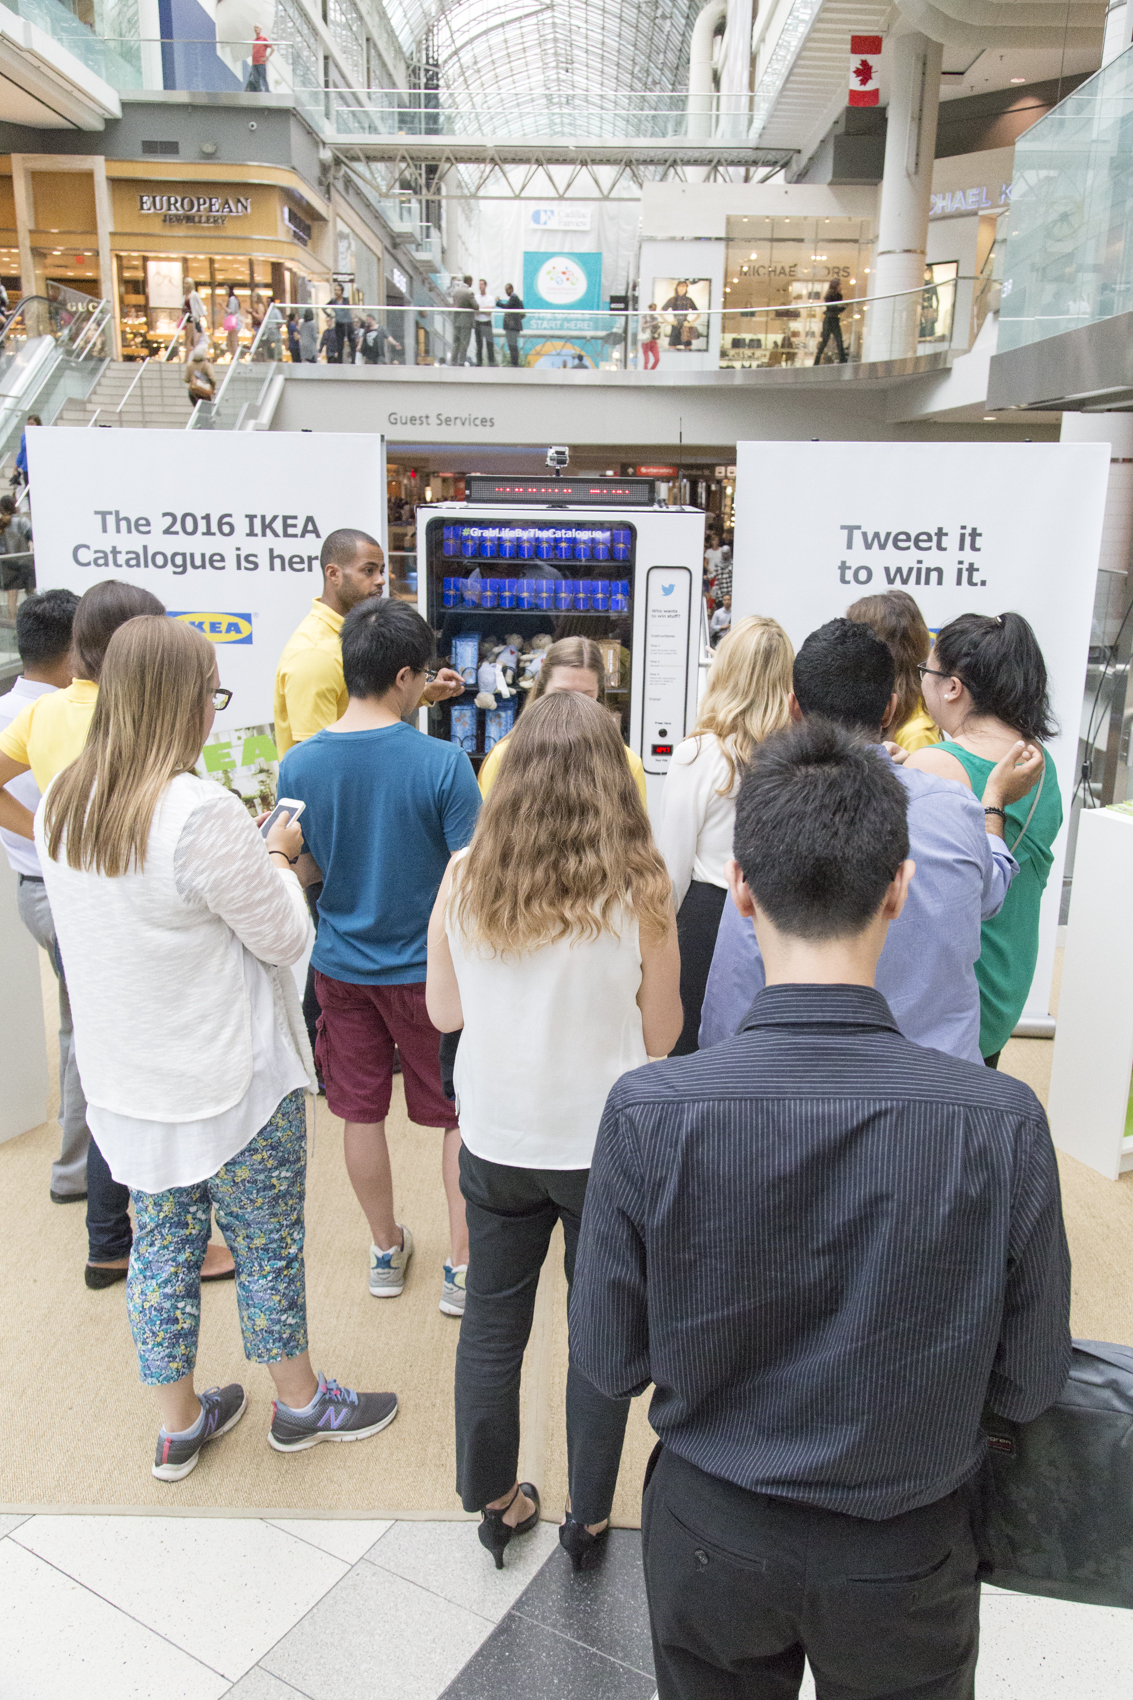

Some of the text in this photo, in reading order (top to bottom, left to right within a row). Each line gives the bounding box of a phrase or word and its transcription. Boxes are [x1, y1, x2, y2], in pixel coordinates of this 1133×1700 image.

[138, 194, 251, 215] EUROPEAN
[162, 213, 227, 226] JEWELLERY
[67, 301, 98, 313] GUC
[530, 319, 594, 330] START HERE!
[387, 412, 495, 428] Guest Services
[94, 509, 321, 538] The 2016 IKEA
[462, 527, 603, 539] #GrabLifeByTheCatalogue
[840, 524, 983, 552] Tweet it
[72, 543, 319, 576] Catalogue is her
[837, 559, 987, 587] to win it.
[183, 621, 243, 634] KEA
[199, 734, 279, 773] EA
